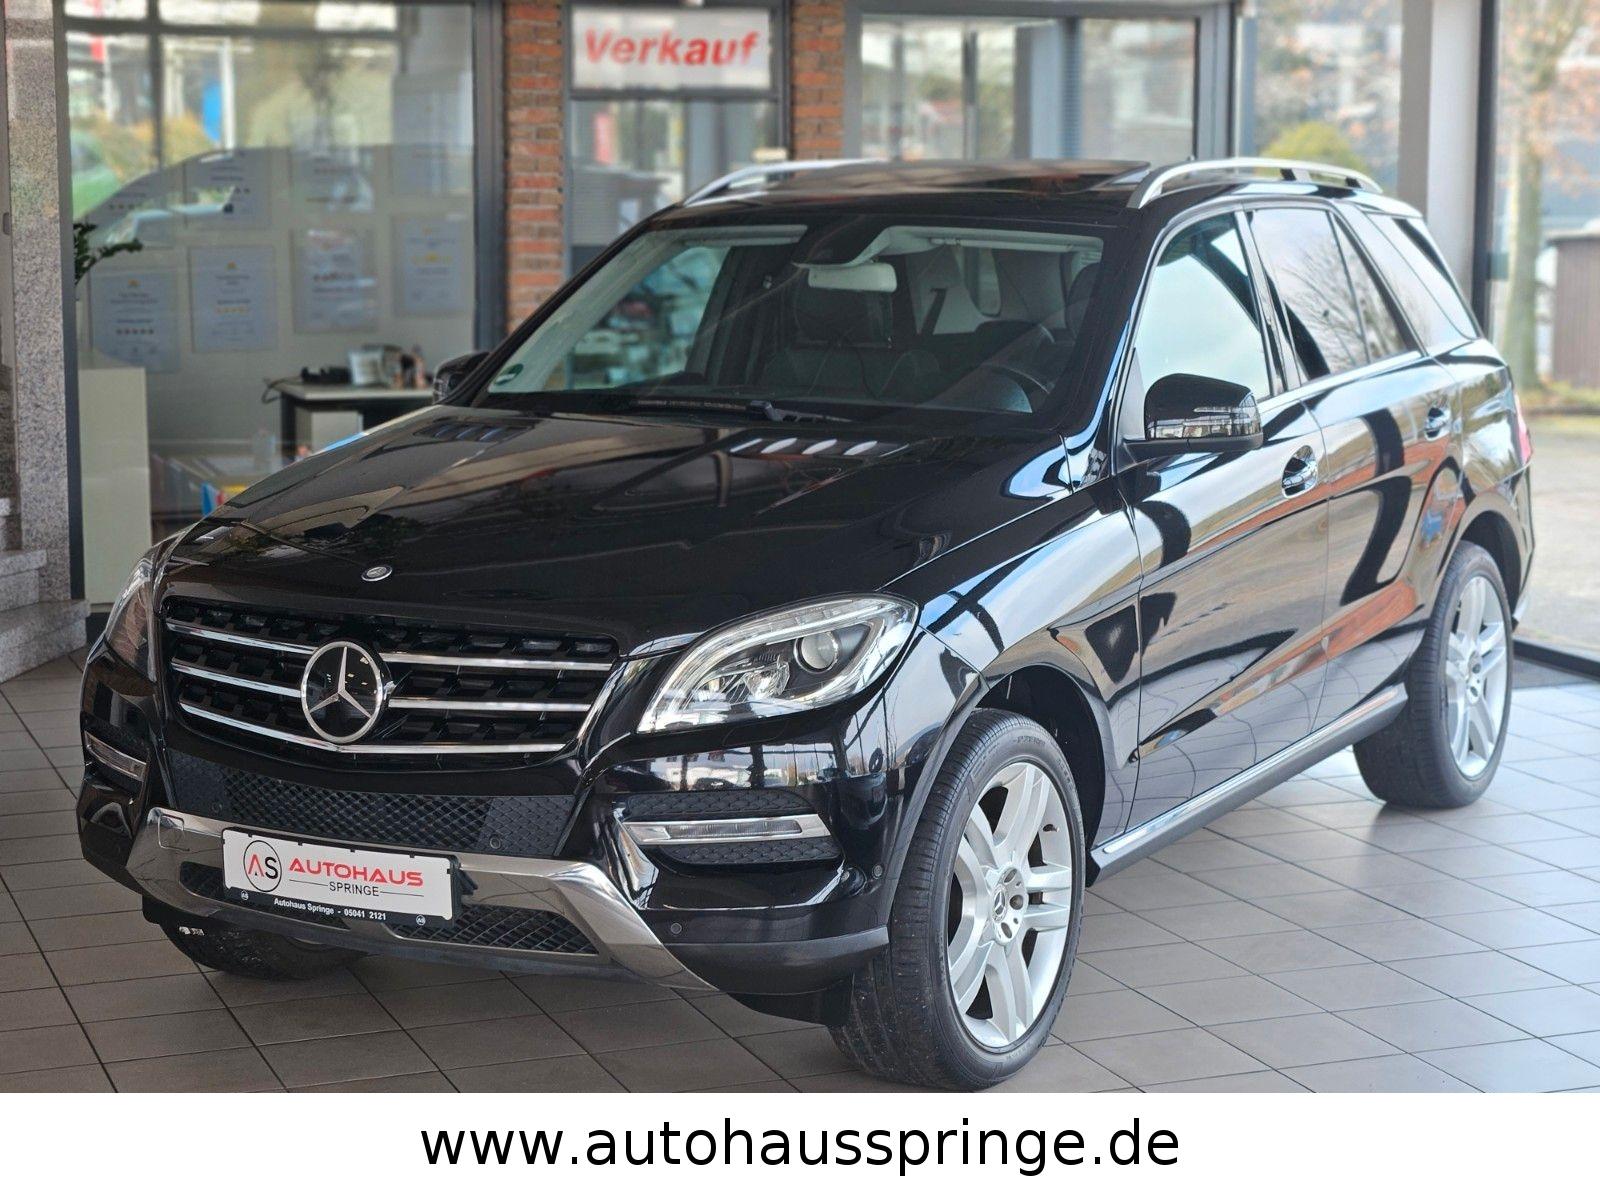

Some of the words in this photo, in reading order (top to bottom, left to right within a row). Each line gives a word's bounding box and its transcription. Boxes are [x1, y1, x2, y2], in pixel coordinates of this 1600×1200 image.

[585, 29, 759, 66] Verkauf
[289, 859, 424, 887] AUTOHAUS
[329, 881, 380, 897] SPRINGE
[274, 898, 306, 910] Autohaus
[307, 903, 334, 915] Springe
[343, 908, 365, 918] 05041
[368, 911, 386, 920] 2121
